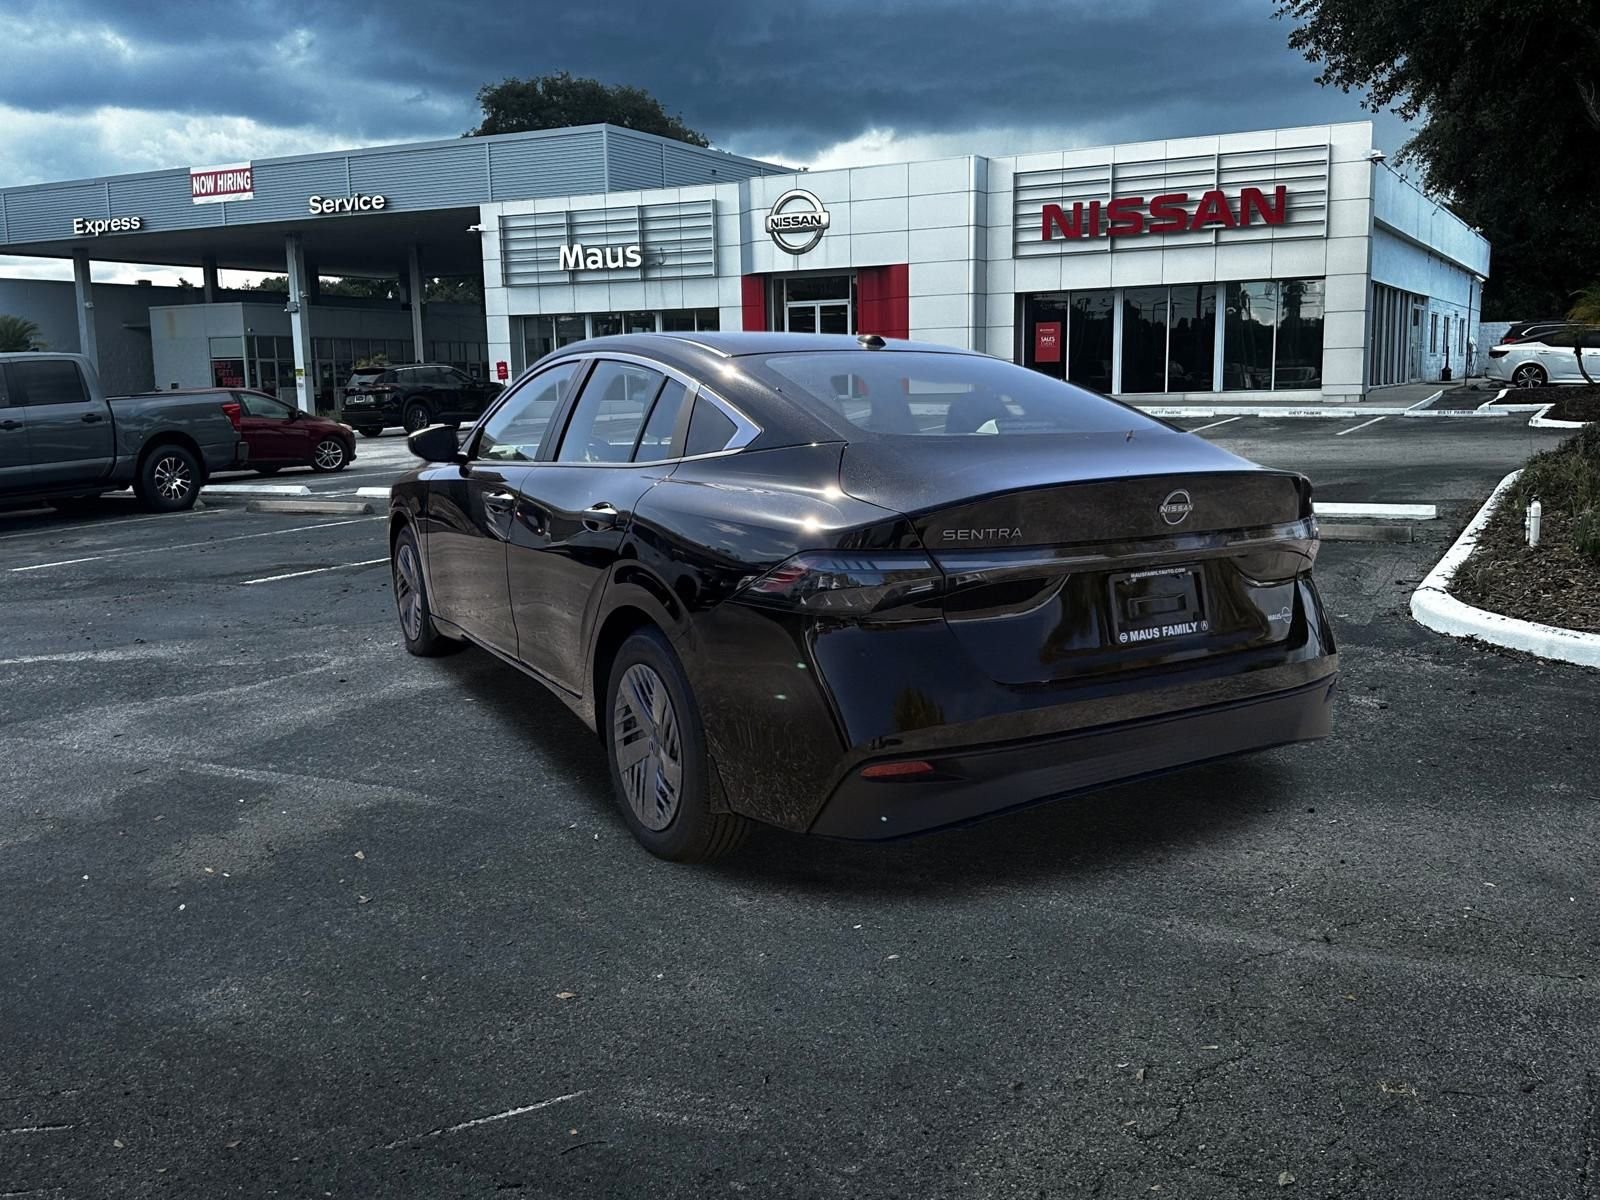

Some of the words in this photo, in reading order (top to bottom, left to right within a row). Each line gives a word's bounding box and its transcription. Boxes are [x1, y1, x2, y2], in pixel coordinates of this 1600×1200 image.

[192, 174, 215, 195] NOW
[217, 171, 251, 192] HIRING
[308, 193, 386, 215] Service
[1041, 185, 1287, 241] NISSAN
[73, 216, 141, 237] Express
[770, 215, 822, 228] NISSAN
[559, 243, 642, 271] Maus
[1160, 503, 1194, 513] NISSAN
[942, 527, 1023, 542] SENTRA
[1130, 567, 1185, 578] MAUSFAMILYAUTO.COM
[1129, 627, 1160, 642] MAUS
[1162, 621, 1198, 637] FAMILY
